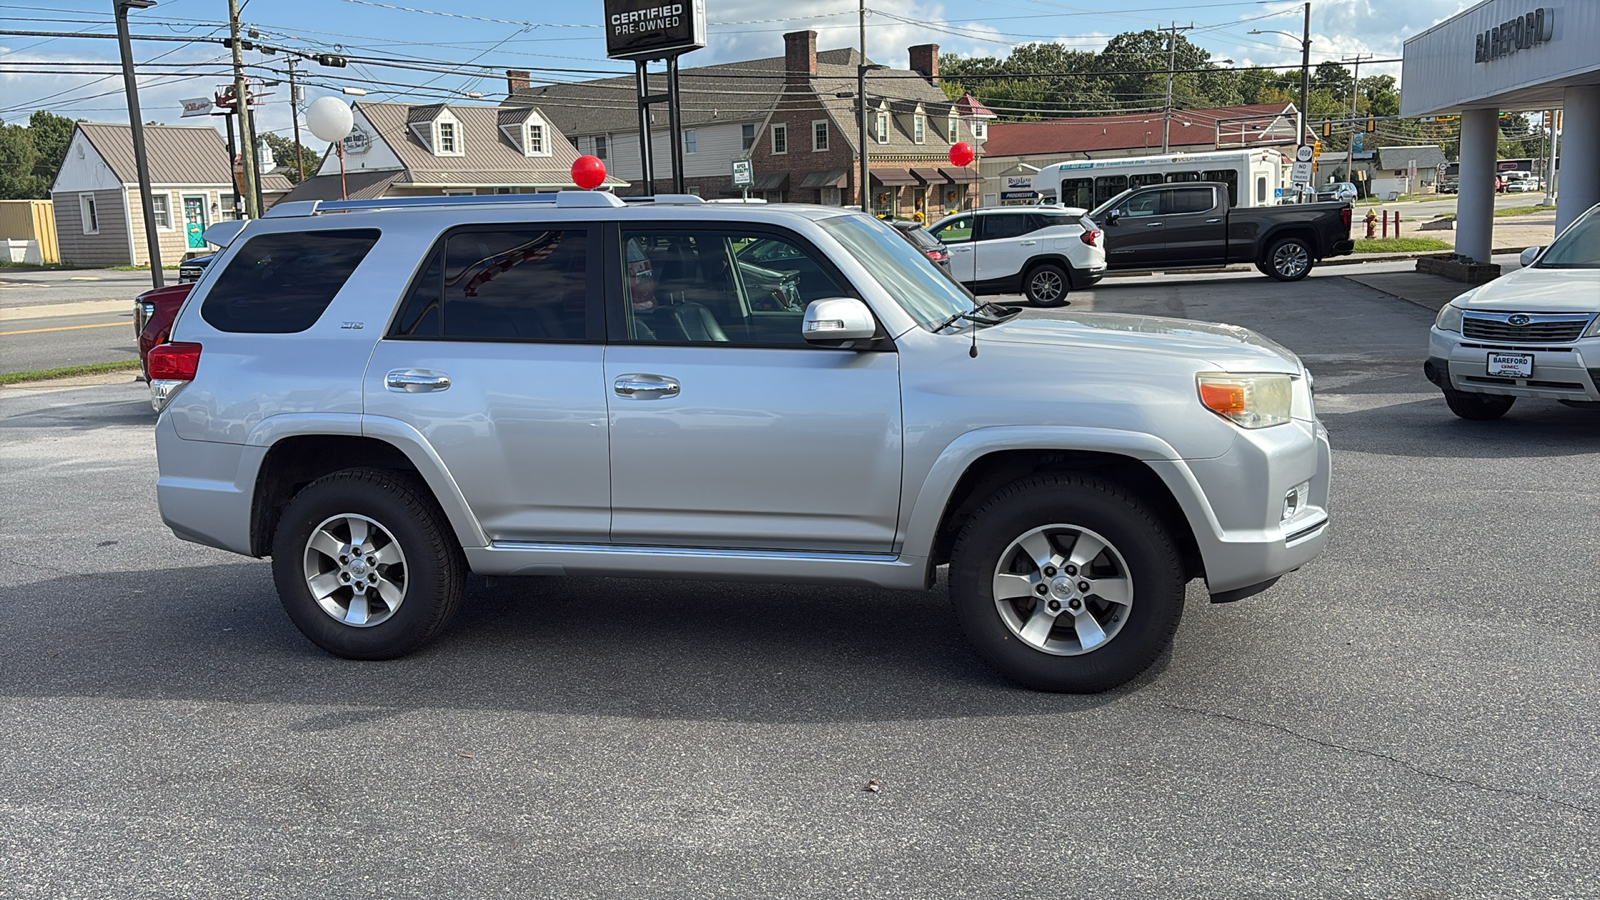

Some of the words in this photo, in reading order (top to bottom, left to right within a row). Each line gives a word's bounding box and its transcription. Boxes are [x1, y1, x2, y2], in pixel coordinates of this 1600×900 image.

[611, 4, 682, 25] CERTIFIED
[615, 16, 680, 36] PRE-OWNED
[1475, 8, 1554, 64] BAREFORD
[1299, 149, 1311, 157] 1008
[1493, 357, 1528, 365] BAREFORD
